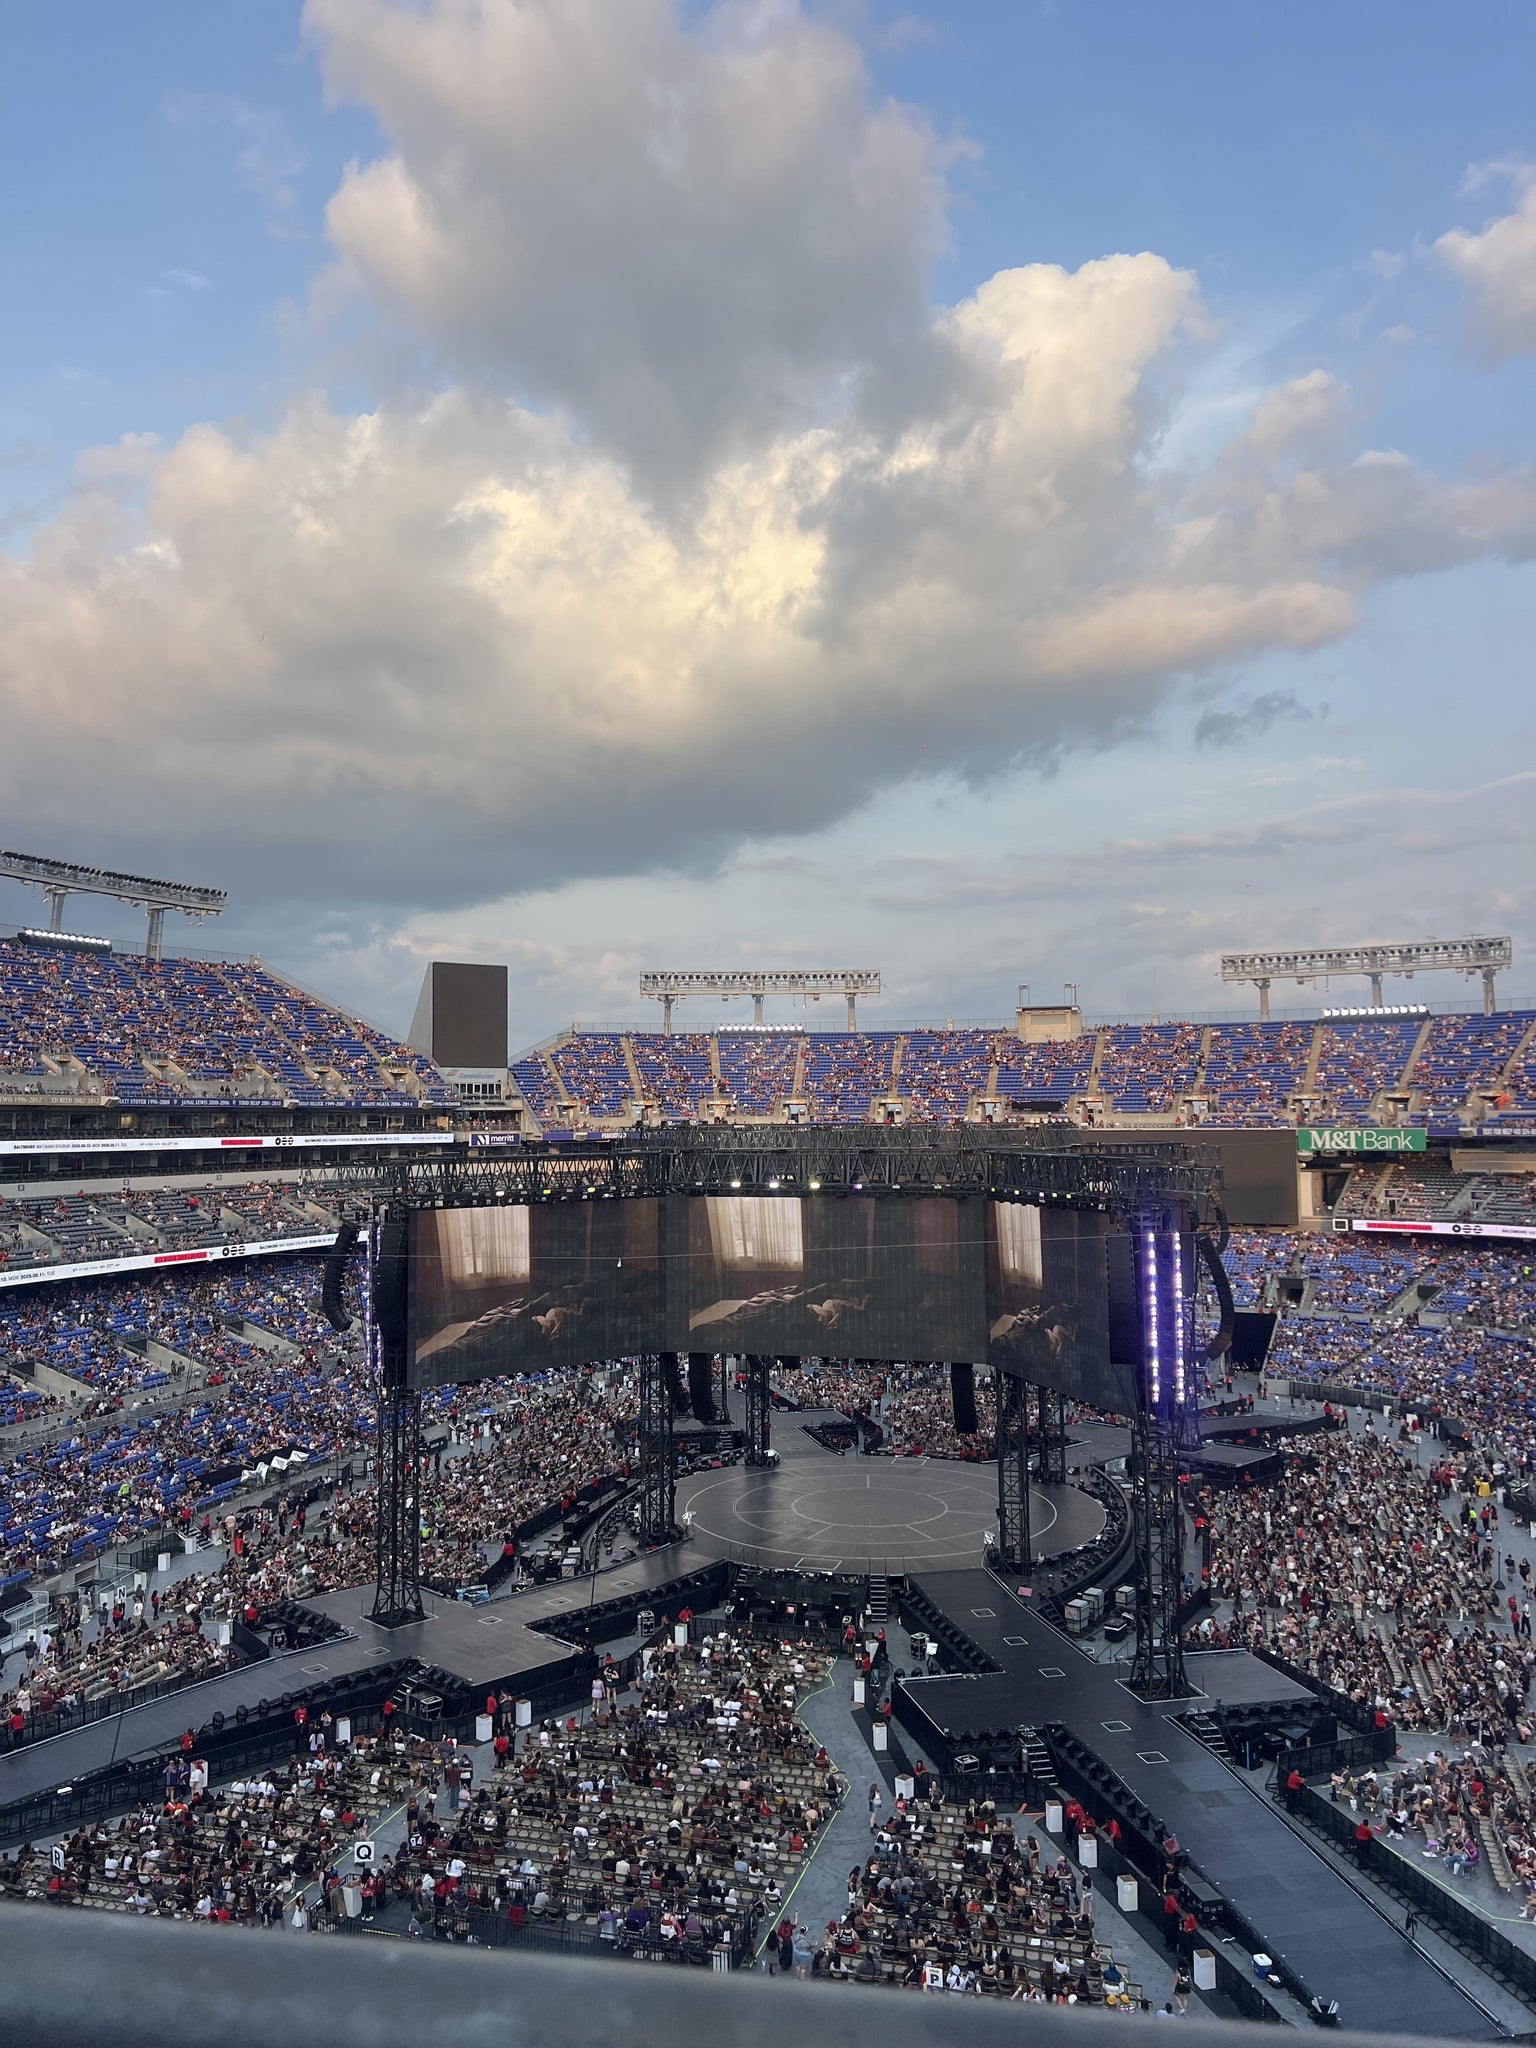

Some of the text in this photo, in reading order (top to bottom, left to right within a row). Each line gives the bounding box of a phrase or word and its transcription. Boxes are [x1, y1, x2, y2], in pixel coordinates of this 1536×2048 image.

[1309, 1130, 1414, 1150] M&T Bank
[118, 1586, 126, 1599] N
[54, 1849, 62, 1868] R
[356, 1844, 372, 1860] Q
[930, 1973, 940, 1985] P
